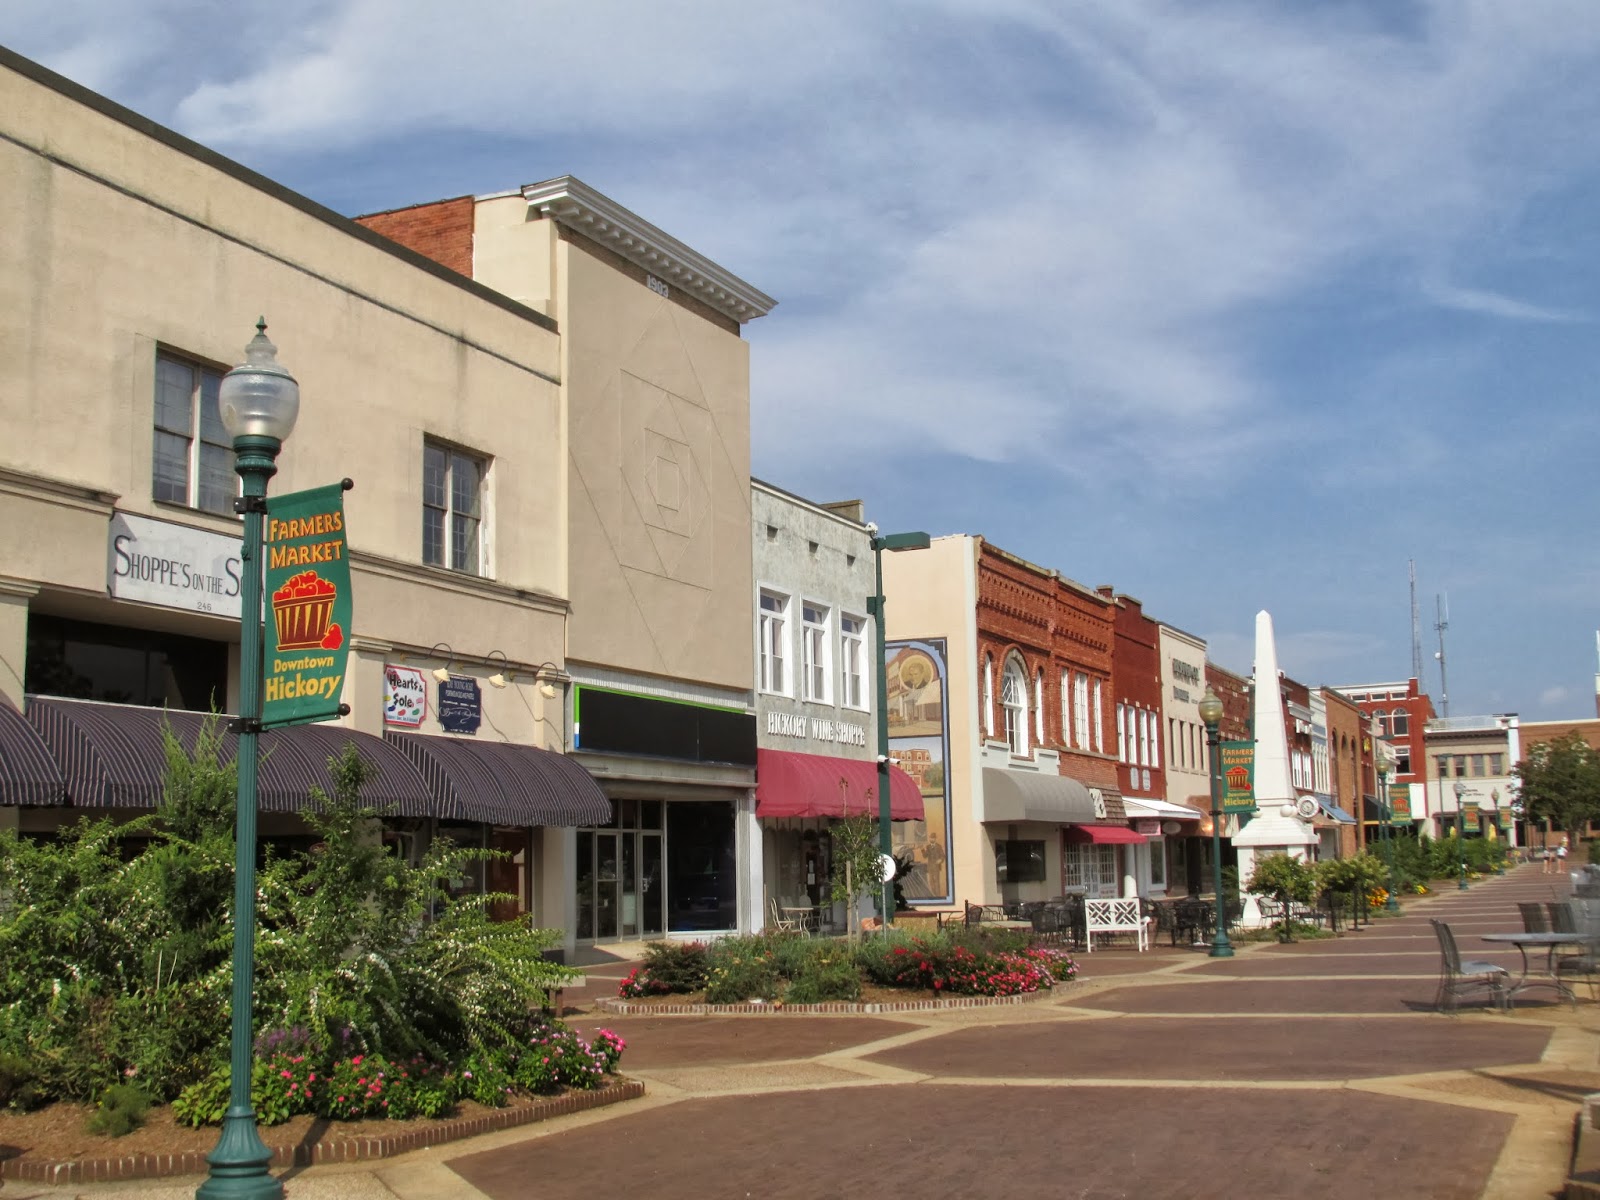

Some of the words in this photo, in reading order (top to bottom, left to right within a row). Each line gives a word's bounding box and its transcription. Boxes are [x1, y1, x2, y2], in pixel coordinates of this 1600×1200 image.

[269, 511, 343, 542] FARMERS
[270, 539, 344, 570] MARKET
[113, 534, 191, 589] SHOPPE'S
[192, 573, 204, 592] ON
[206, 575, 223, 595] THE
[197, 601, 212, 612] 246
[273, 656, 335, 674] Downtown
[265, 672, 341, 702] Hickory
[389, 674, 418, 691] Hearts
[393, 692, 413, 708] Sole
[767, 712, 806, 736] HICKORY
[811, 718, 834, 740] WINE
[836, 722, 865, 745] SHOPPE
[1222, 748, 1254, 757] FARMERS
[1223, 757, 1253, 765] MARKET
[1223, 797, 1255, 806] Hickory
